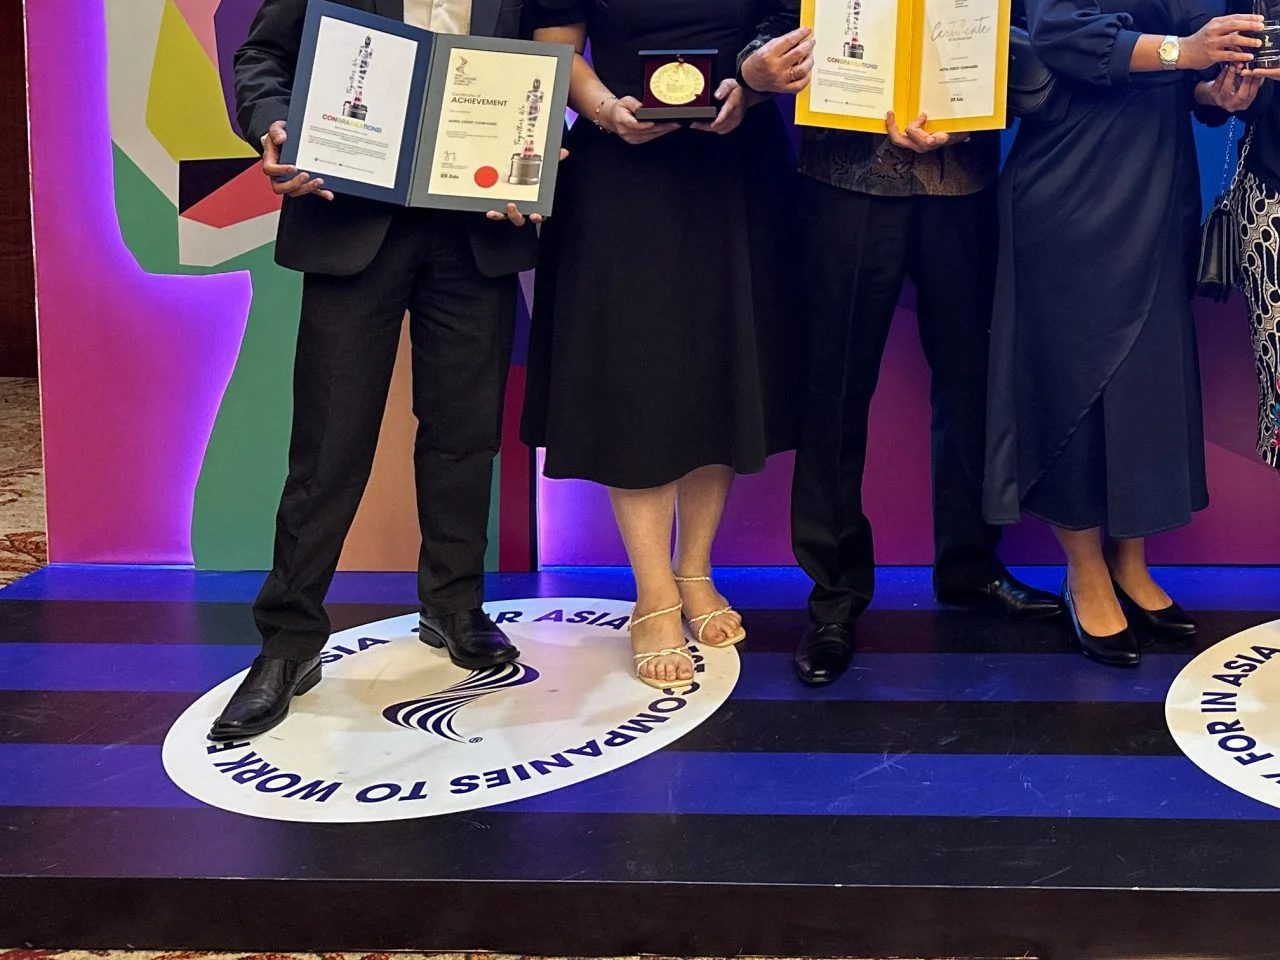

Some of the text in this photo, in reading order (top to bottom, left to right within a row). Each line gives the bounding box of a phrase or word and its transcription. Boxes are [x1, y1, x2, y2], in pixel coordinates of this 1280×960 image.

[827, 56, 878, 70] CONGRATIONS!
[451, 96, 508, 107] ACHIEVEMENT
[322, 113, 383, 134] CONGRATIONS!
[533, 609, 630, 630] ASIA
[320, 636, 393, 666] SIA
[1201, 691, 1238, 713] IN
[212, 681, 701, 803] COMPANIES TO WORK
[1206, 718, 1274, 766] FOR
